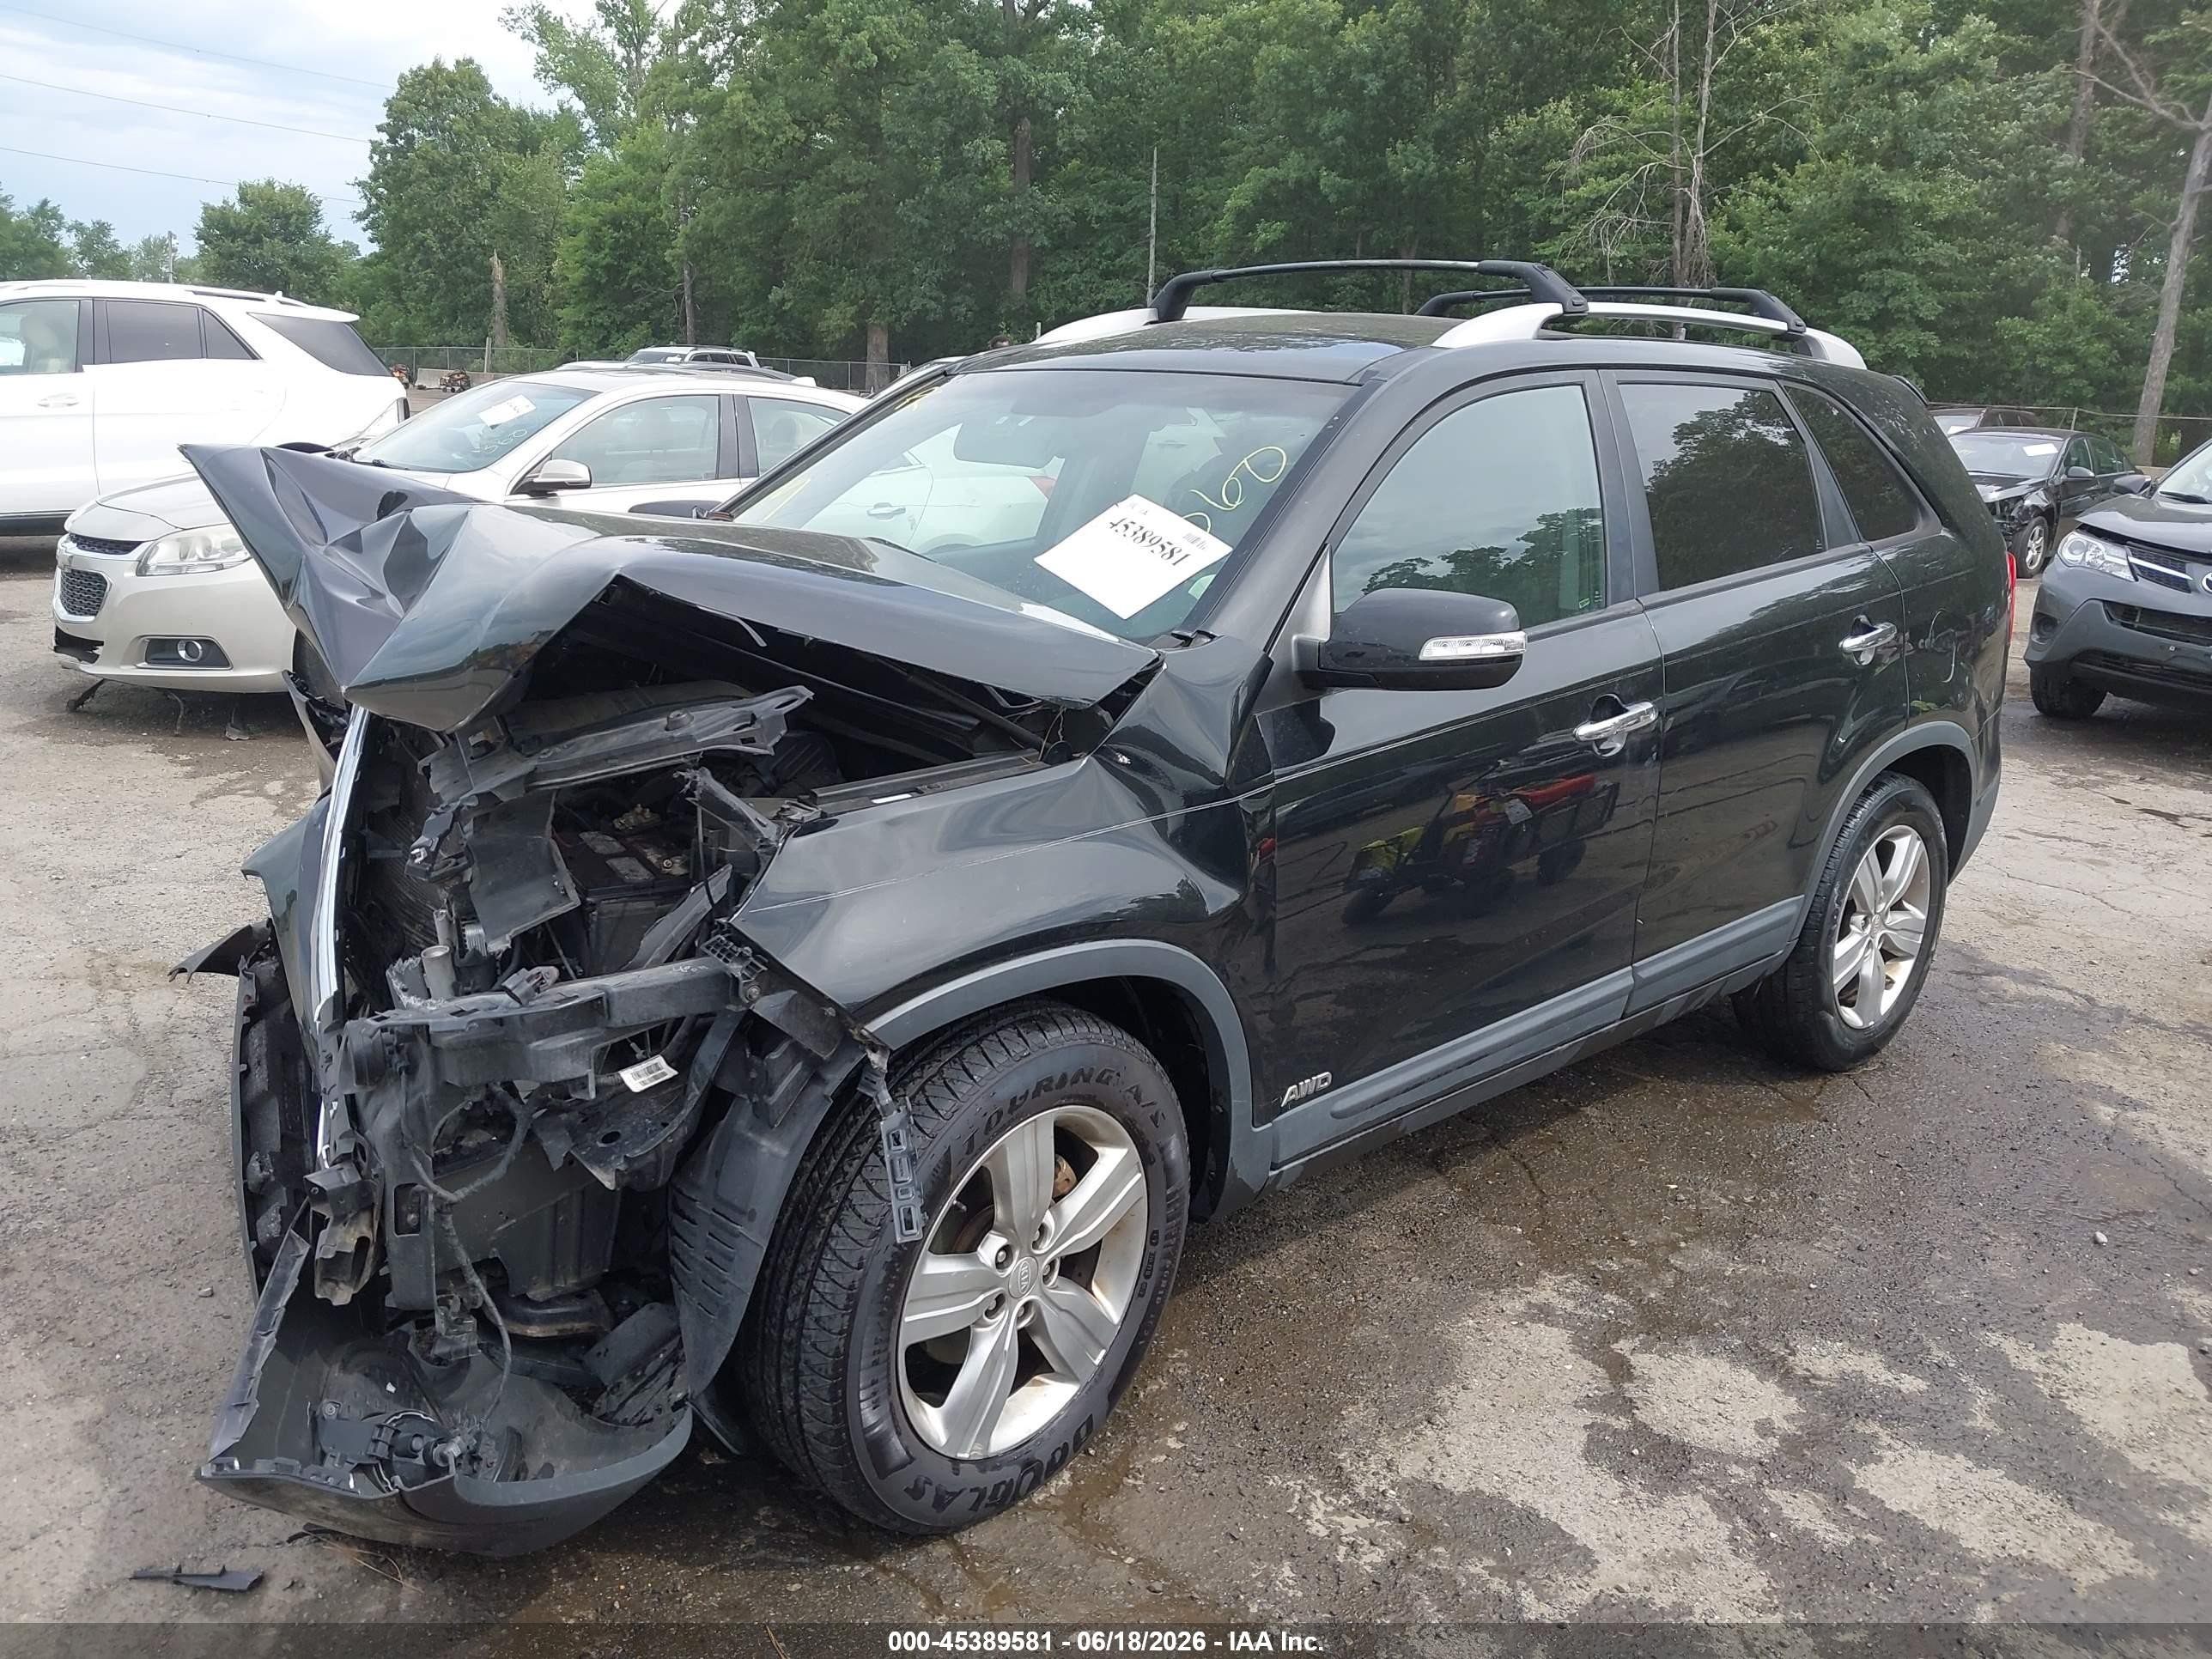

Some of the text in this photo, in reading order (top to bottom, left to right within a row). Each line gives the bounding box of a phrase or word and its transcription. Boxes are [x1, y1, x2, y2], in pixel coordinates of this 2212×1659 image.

[1109, 517, 1191, 567] 45389581
[962, 1066, 1121, 1156] TOURING
[1280, 1071, 1333, 1108] AWD
[902, 1413, 1095, 1513] DOUGLAS
